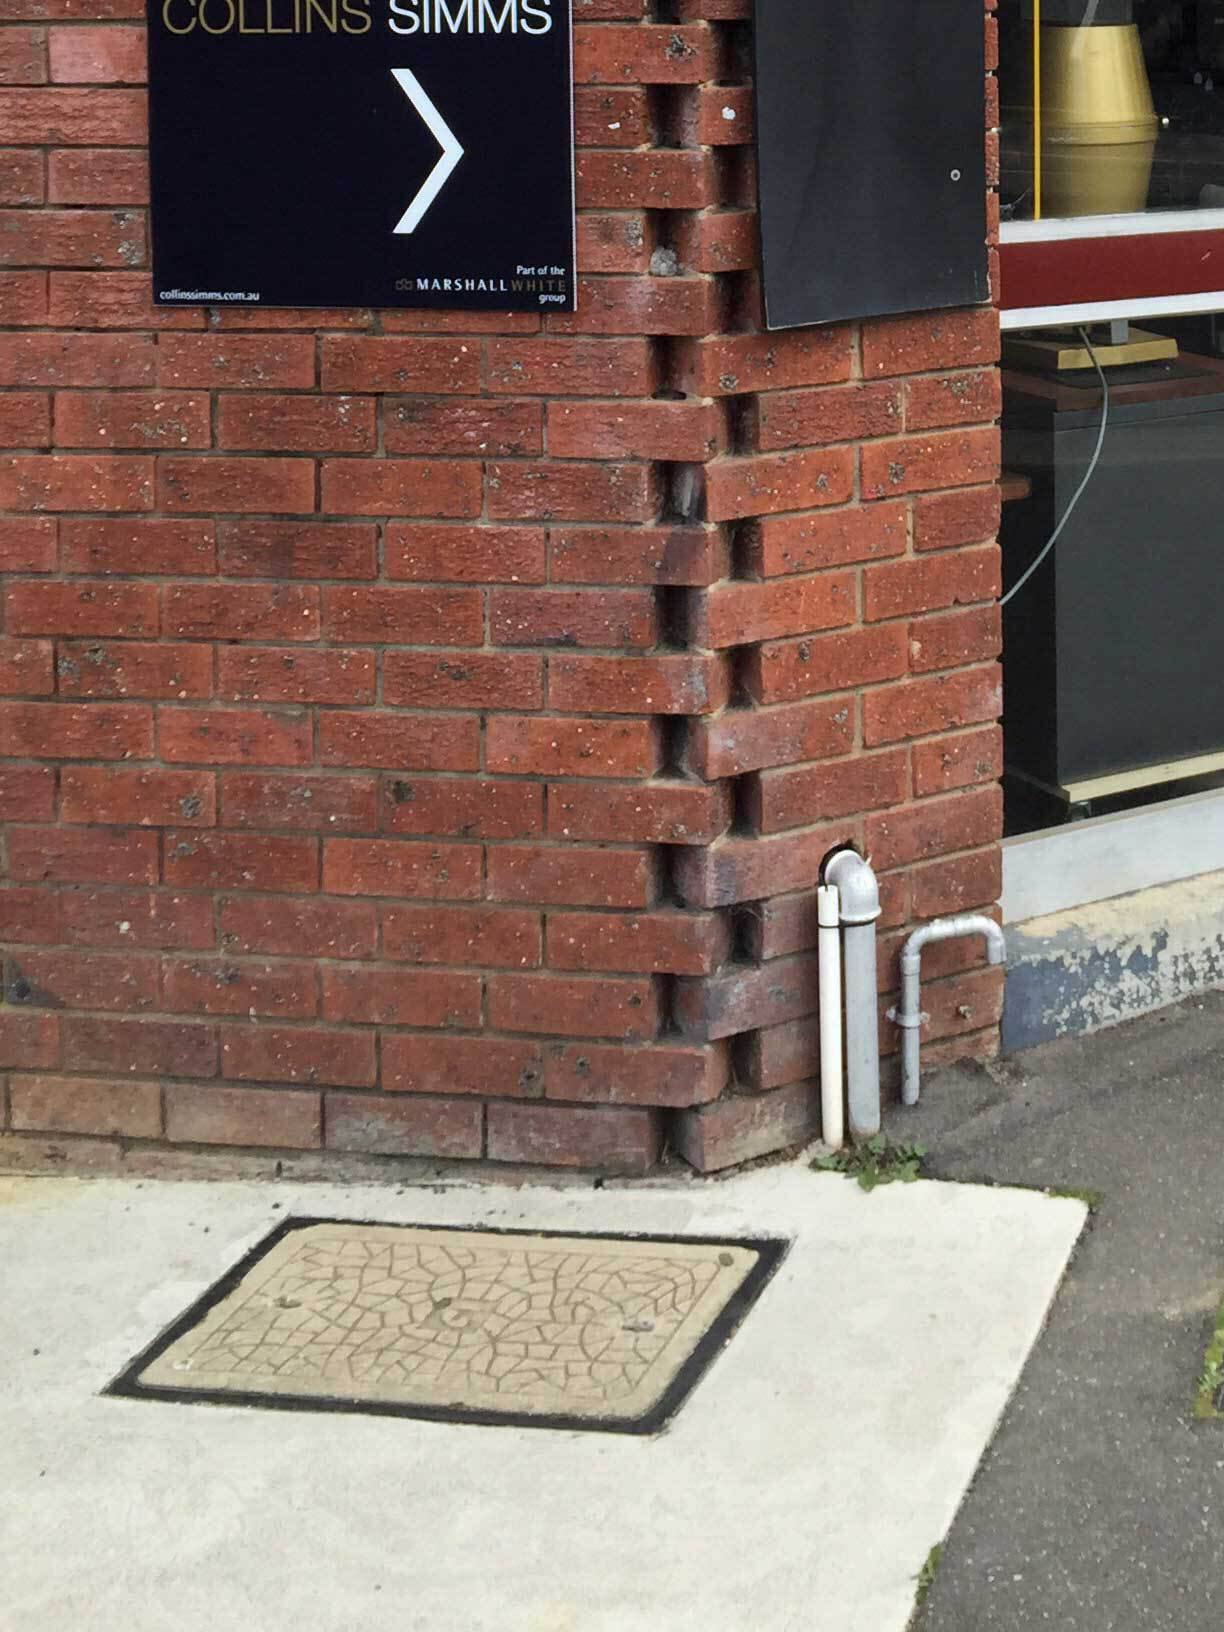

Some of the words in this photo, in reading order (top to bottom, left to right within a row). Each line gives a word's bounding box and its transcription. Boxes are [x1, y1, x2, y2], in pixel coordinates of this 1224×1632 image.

[516, 266, 536, 276] Part
[537, 266, 549, 275] of
[550, 266, 566, 276] the
[416, 278, 508, 292] MARSHALL
[511, 279, 567, 293] WHITE
[159, 289, 260, 301] collinssimms.com.au
[538, 293, 567, 304] group
